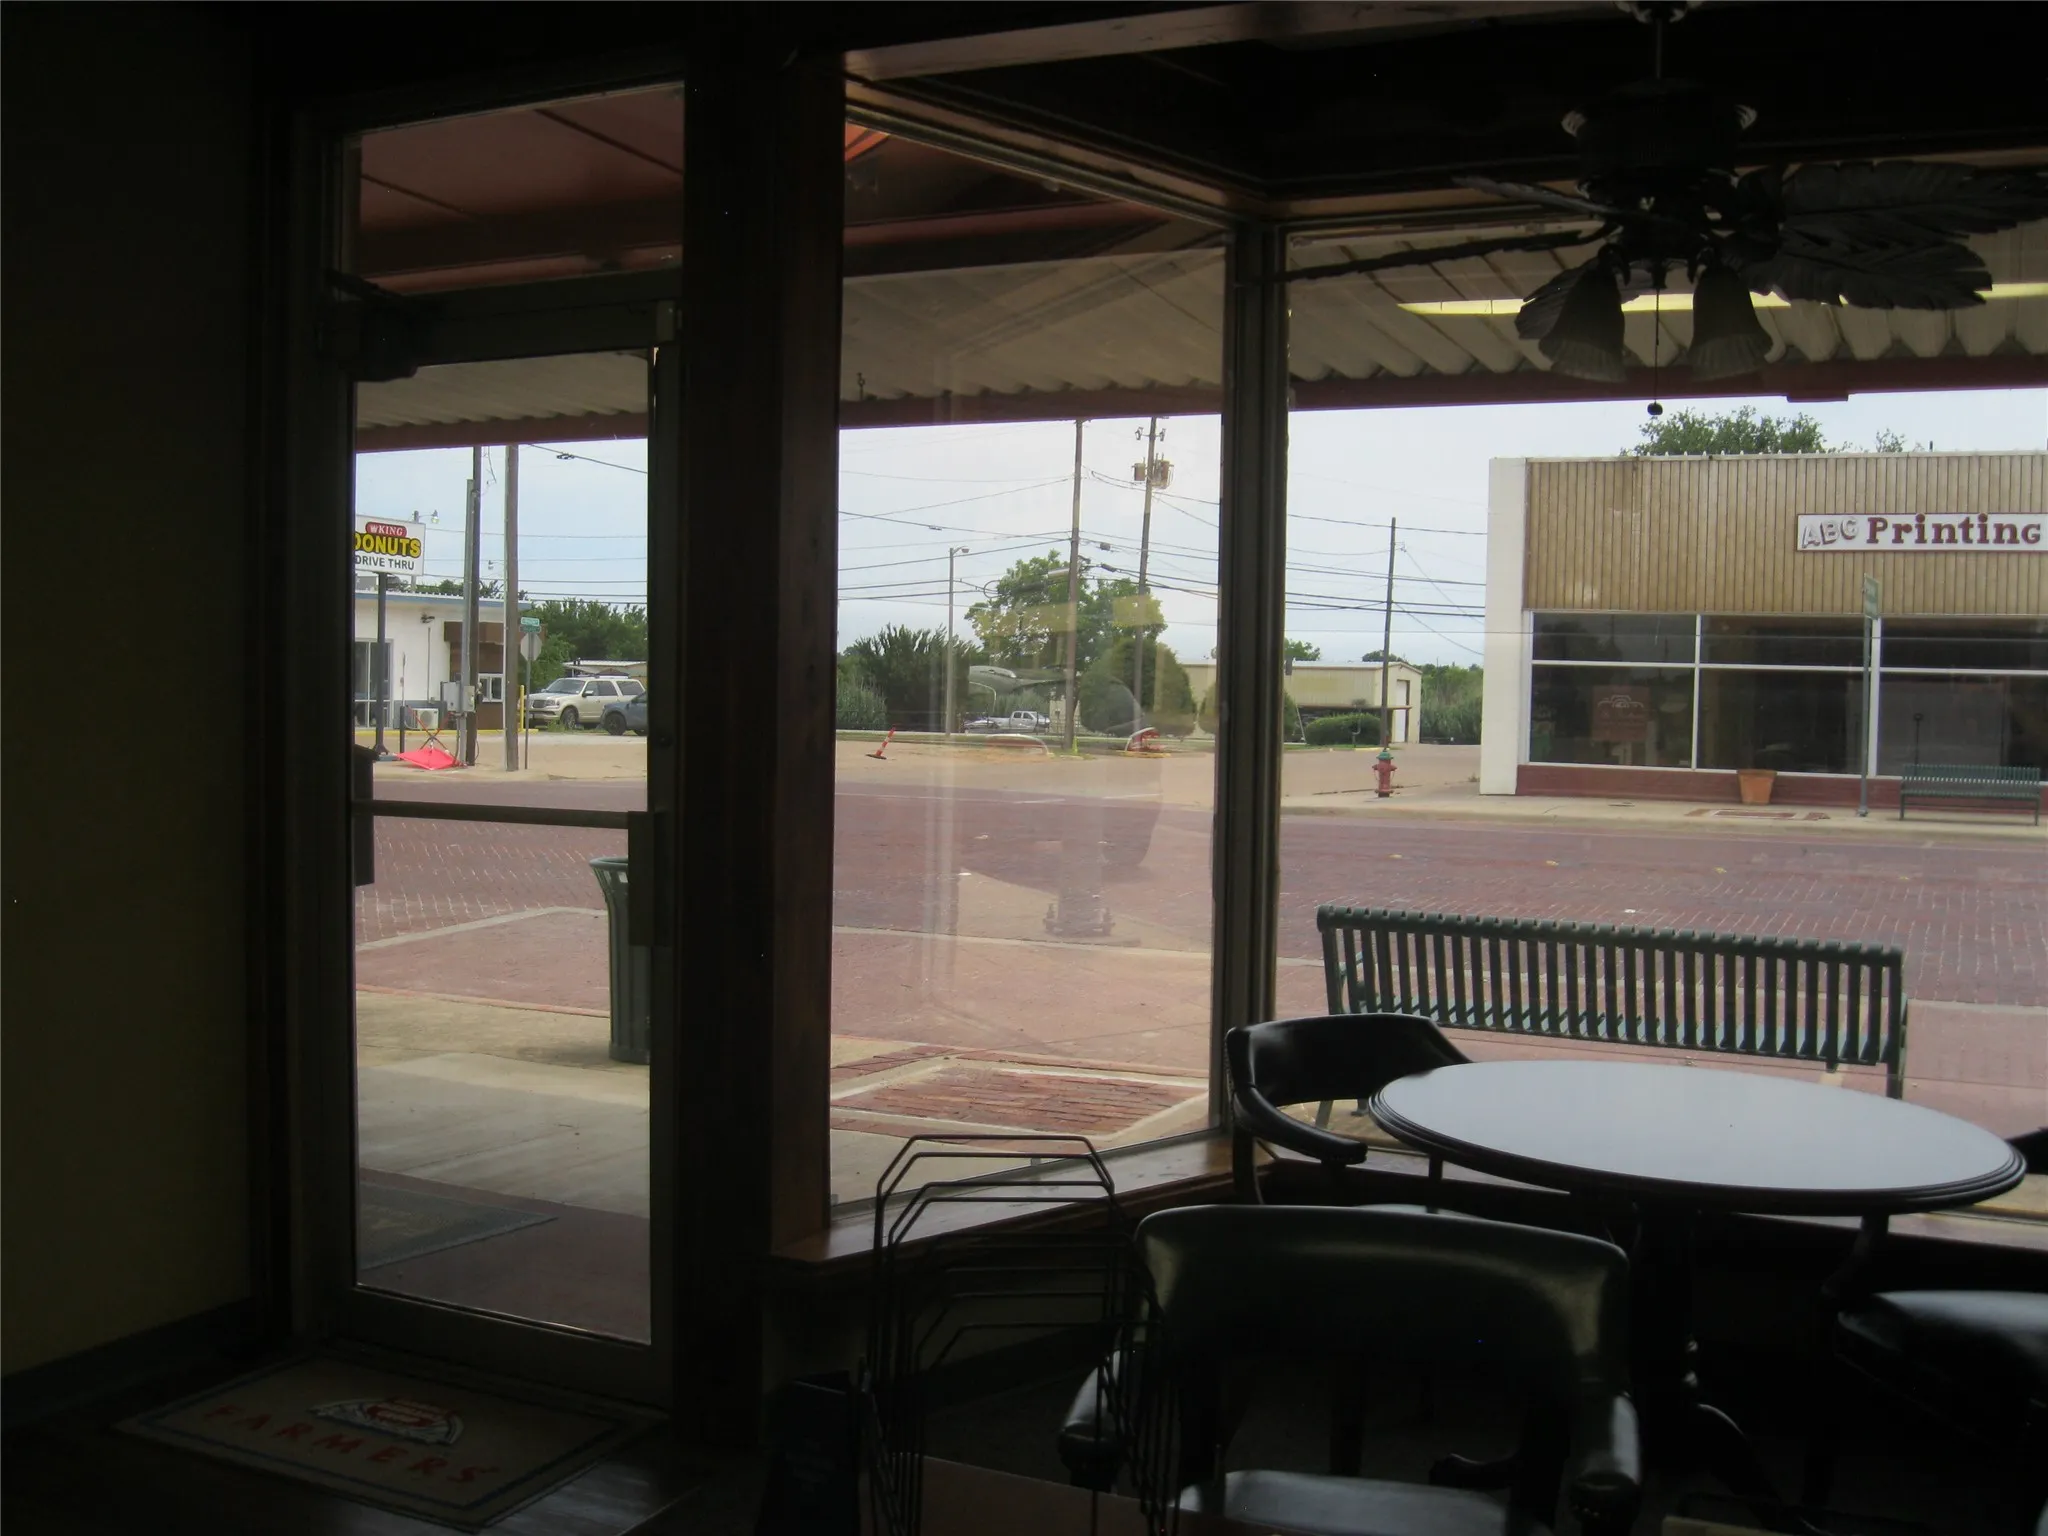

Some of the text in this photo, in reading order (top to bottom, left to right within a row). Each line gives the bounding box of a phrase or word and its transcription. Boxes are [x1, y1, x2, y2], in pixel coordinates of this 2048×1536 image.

[379, 526, 403, 537] KING
[1802, 518, 1858, 548] ABC
[355, 556, 415, 571] DRIVE THRU
[205, 1403, 500, 1483] FARMERS
